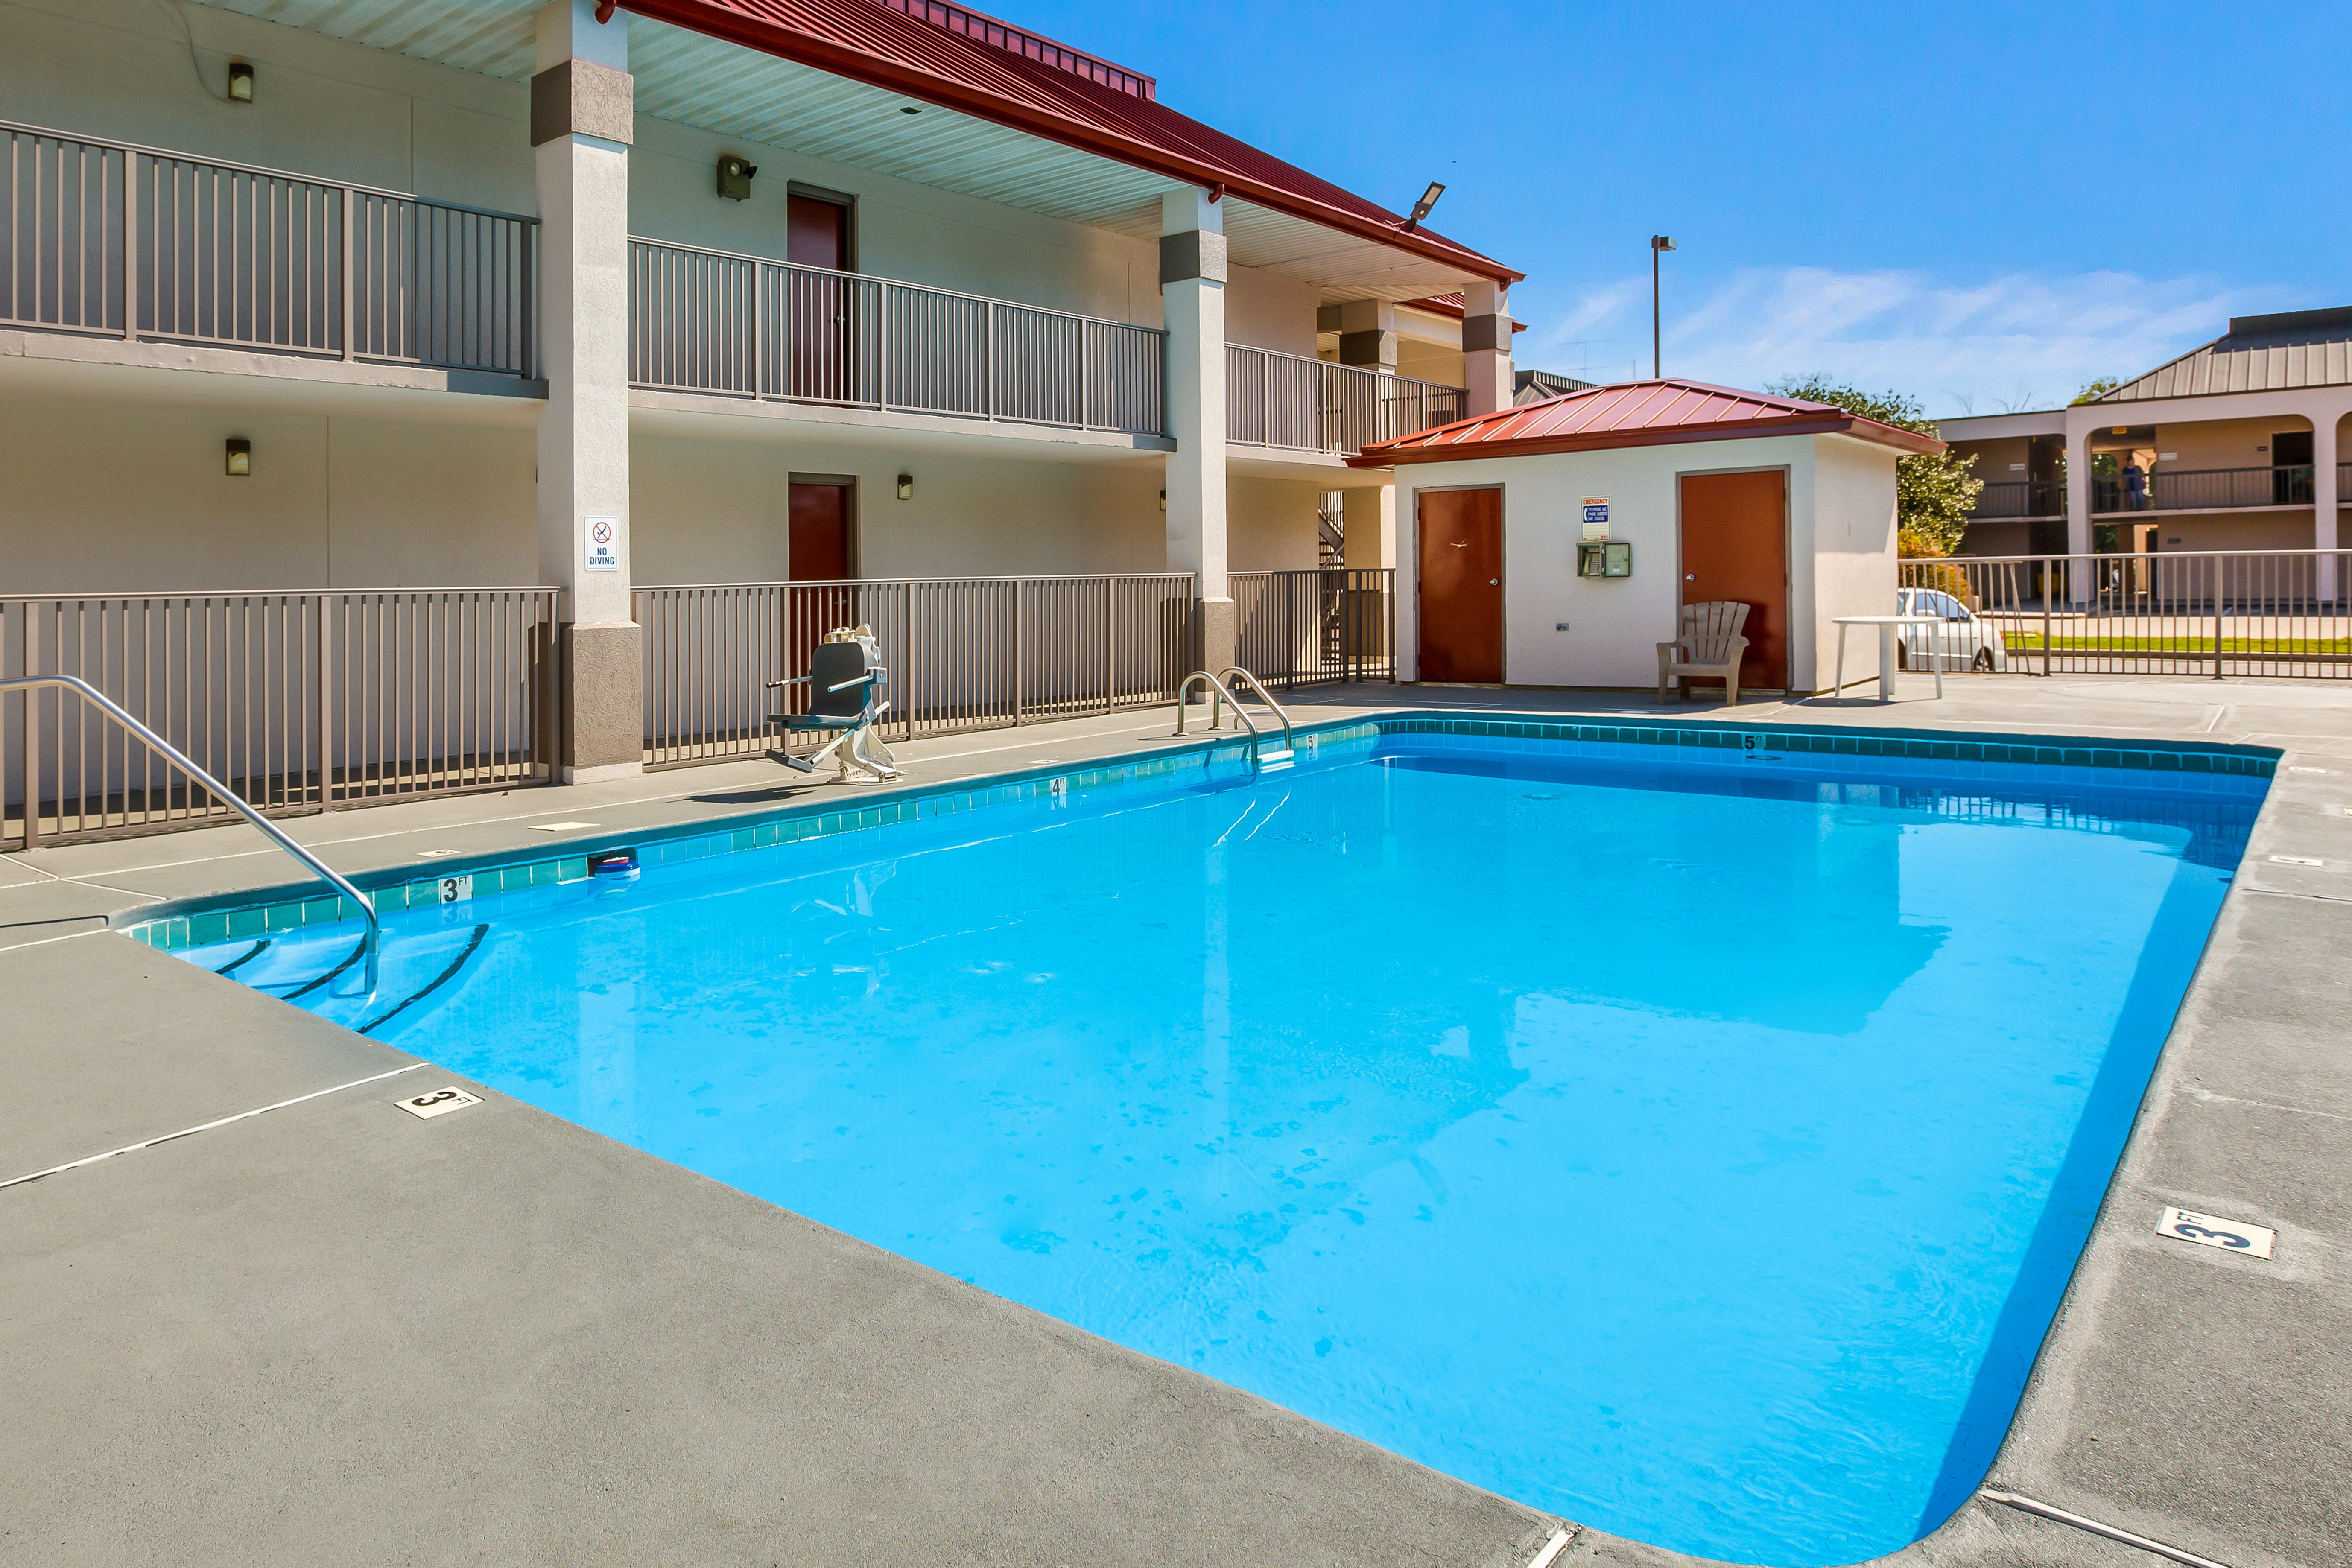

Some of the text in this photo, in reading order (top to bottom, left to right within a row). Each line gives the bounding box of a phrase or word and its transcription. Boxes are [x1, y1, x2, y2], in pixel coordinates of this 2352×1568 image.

[597, 547, 607, 555] NO
[590, 557, 614, 565] DIVING
[1308, 736, 1313, 748] 5
[1745, 735, 1755, 750] 5
[1052, 779, 1060, 794] 4
[444, 876, 468, 902] 3 FT
[411, 1092, 473, 1106] 3 FT
[2173, 1211, 2250, 1248] 3 FT
